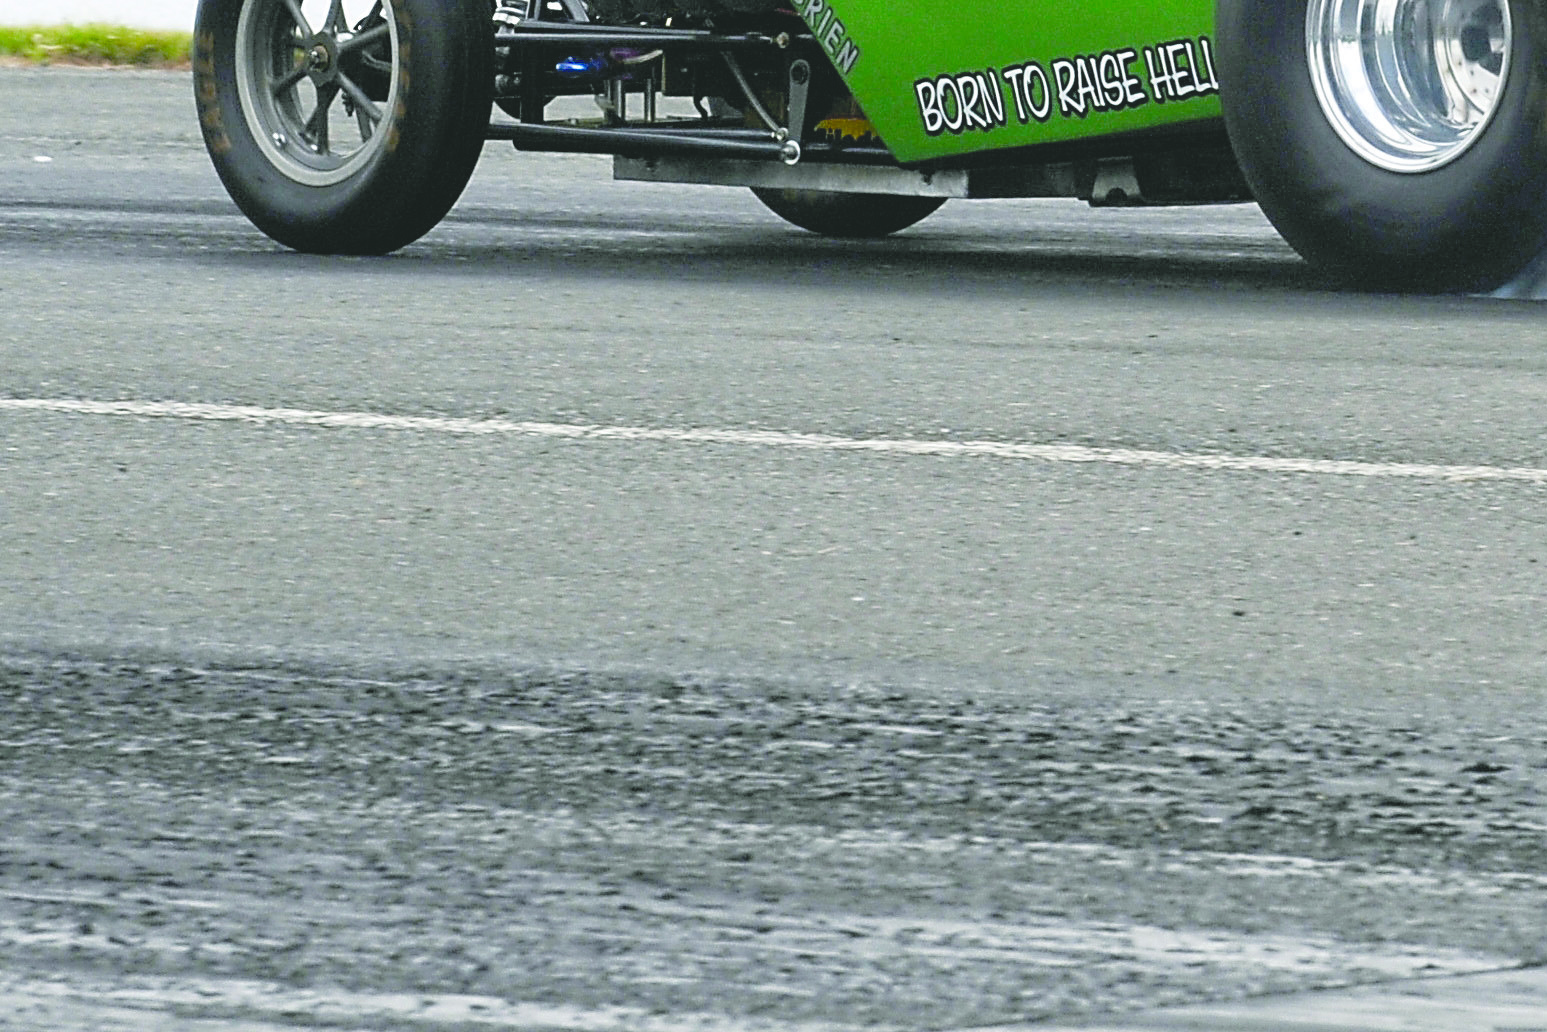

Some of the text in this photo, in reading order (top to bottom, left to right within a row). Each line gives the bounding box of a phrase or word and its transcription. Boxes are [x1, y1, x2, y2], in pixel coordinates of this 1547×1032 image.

[914, 67, 1006, 136] BORN
[1002, 61, 1053, 124] TO
[1050, 49, 1148, 117] RAISE
